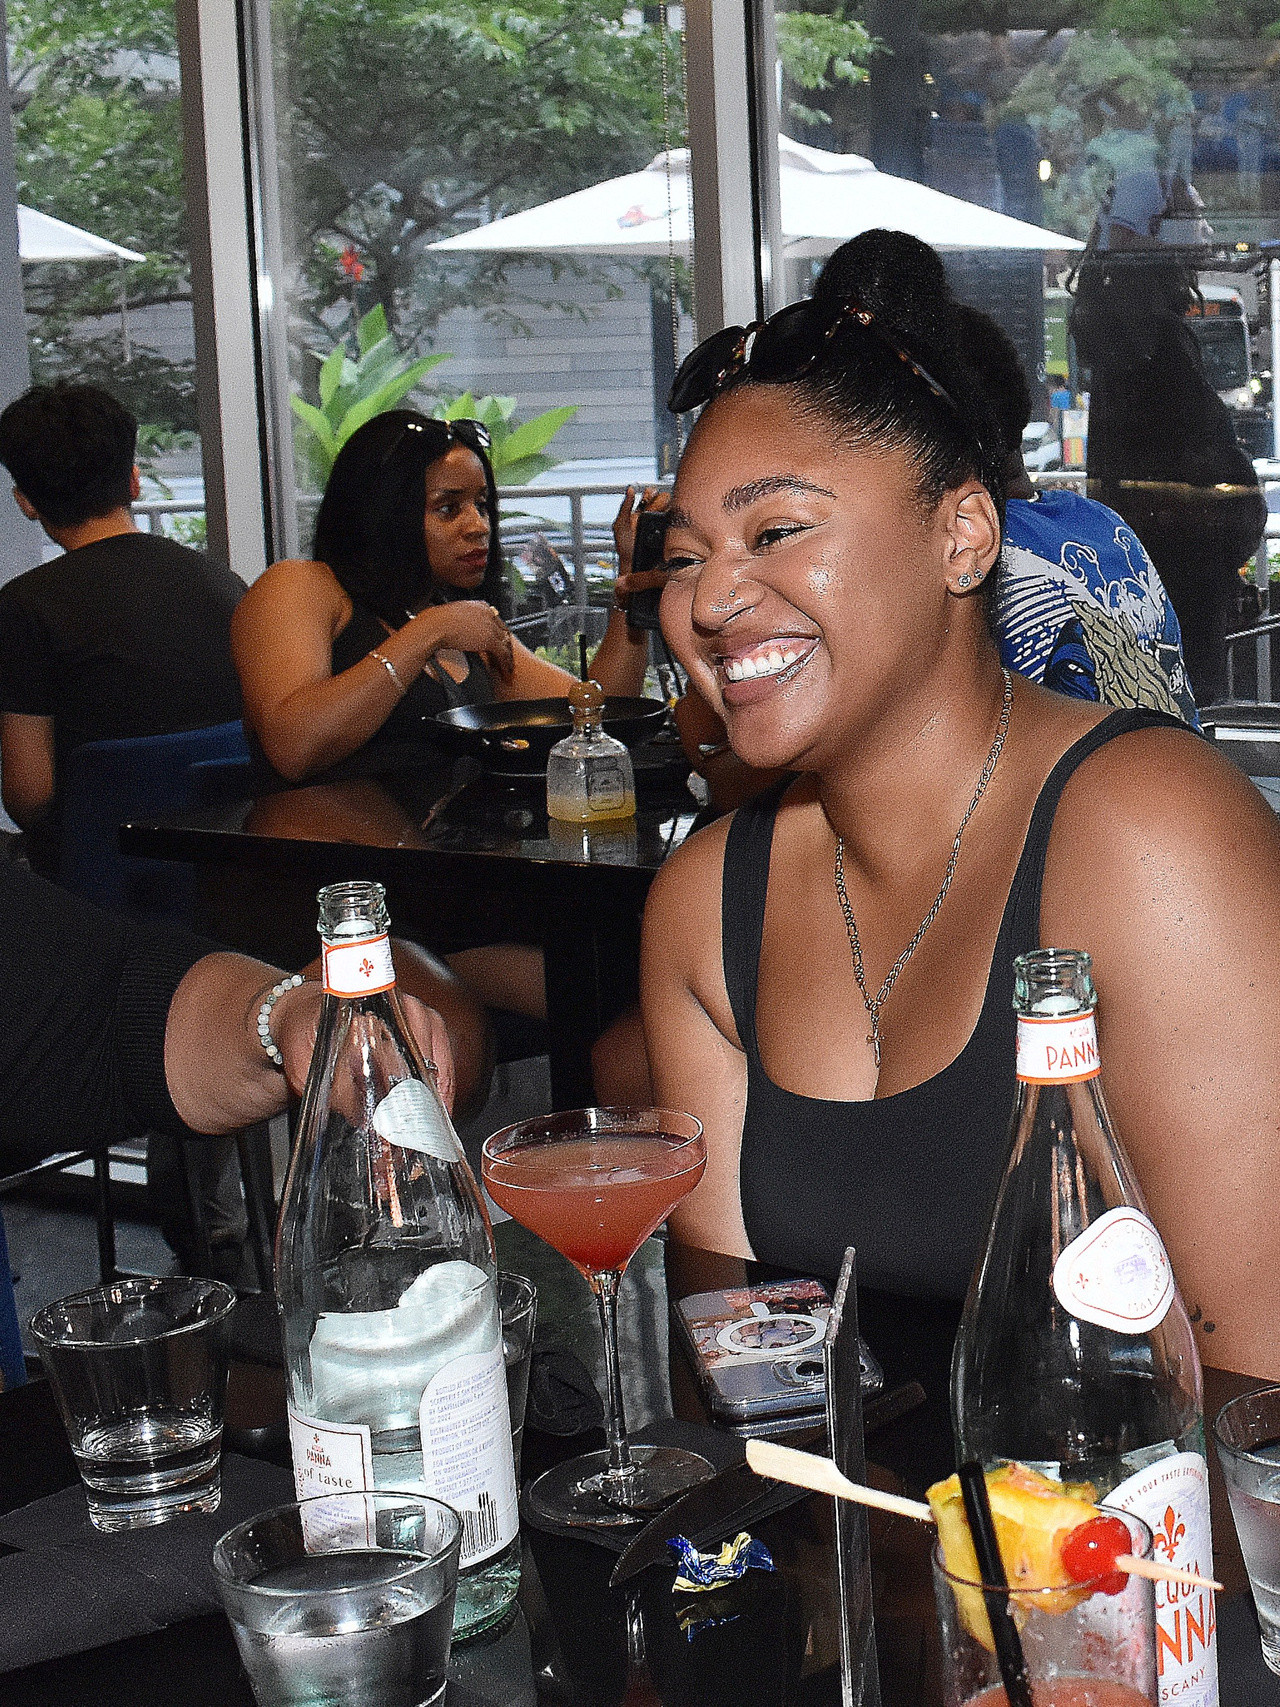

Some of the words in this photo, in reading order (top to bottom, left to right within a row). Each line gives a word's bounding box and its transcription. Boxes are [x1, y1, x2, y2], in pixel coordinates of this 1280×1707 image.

[1046, 1037, 1098, 1071] PANN
[306, 1448, 332, 1467] PANNA
[303, 1467, 315, 1479] of
[318, 1472, 353, 1489] taste
[1138, 1479, 1158, 1496] YOUR
[1160, 1468, 1180, 1483] TASTE
[1156, 1588, 1216, 1677] NNA
[1161, 1665, 1206, 1701] SCANY
